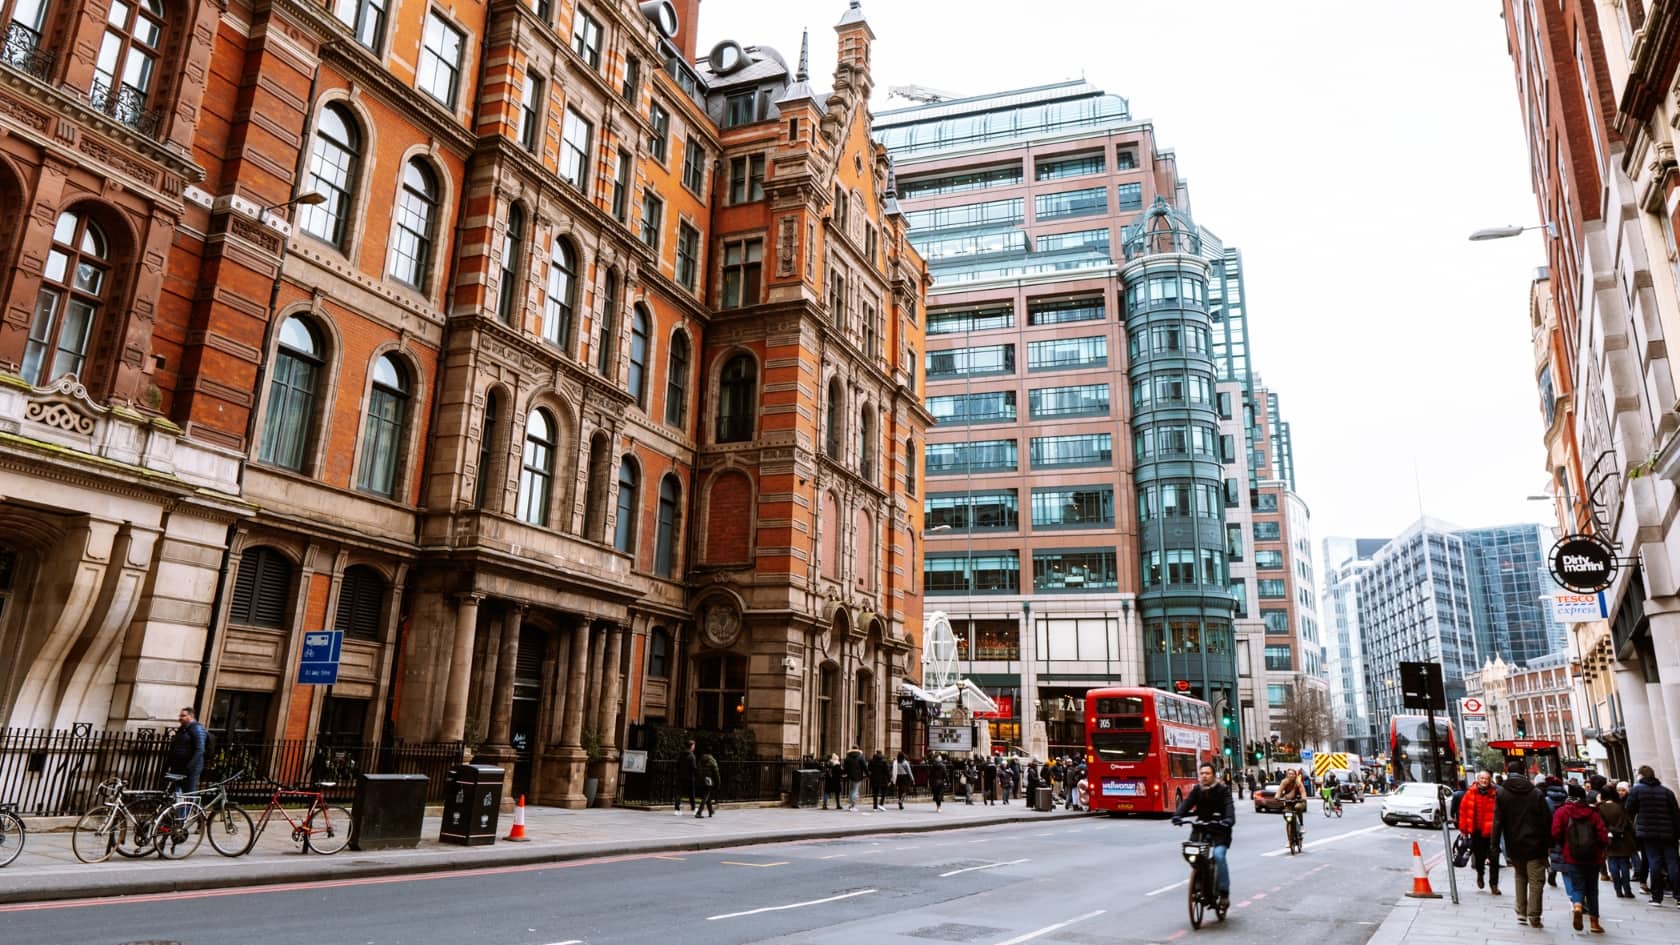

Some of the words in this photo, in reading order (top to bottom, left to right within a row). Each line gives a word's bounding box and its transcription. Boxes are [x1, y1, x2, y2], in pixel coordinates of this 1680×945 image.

[1562, 555, 1590, 565] Dirty
[1564, 561, 1604, 572] martini
[1556, 595, 1595, 603] TESCO
[1558, 606, 1596, 616] express
[1102, 781, 1136, 790] wellwoman
